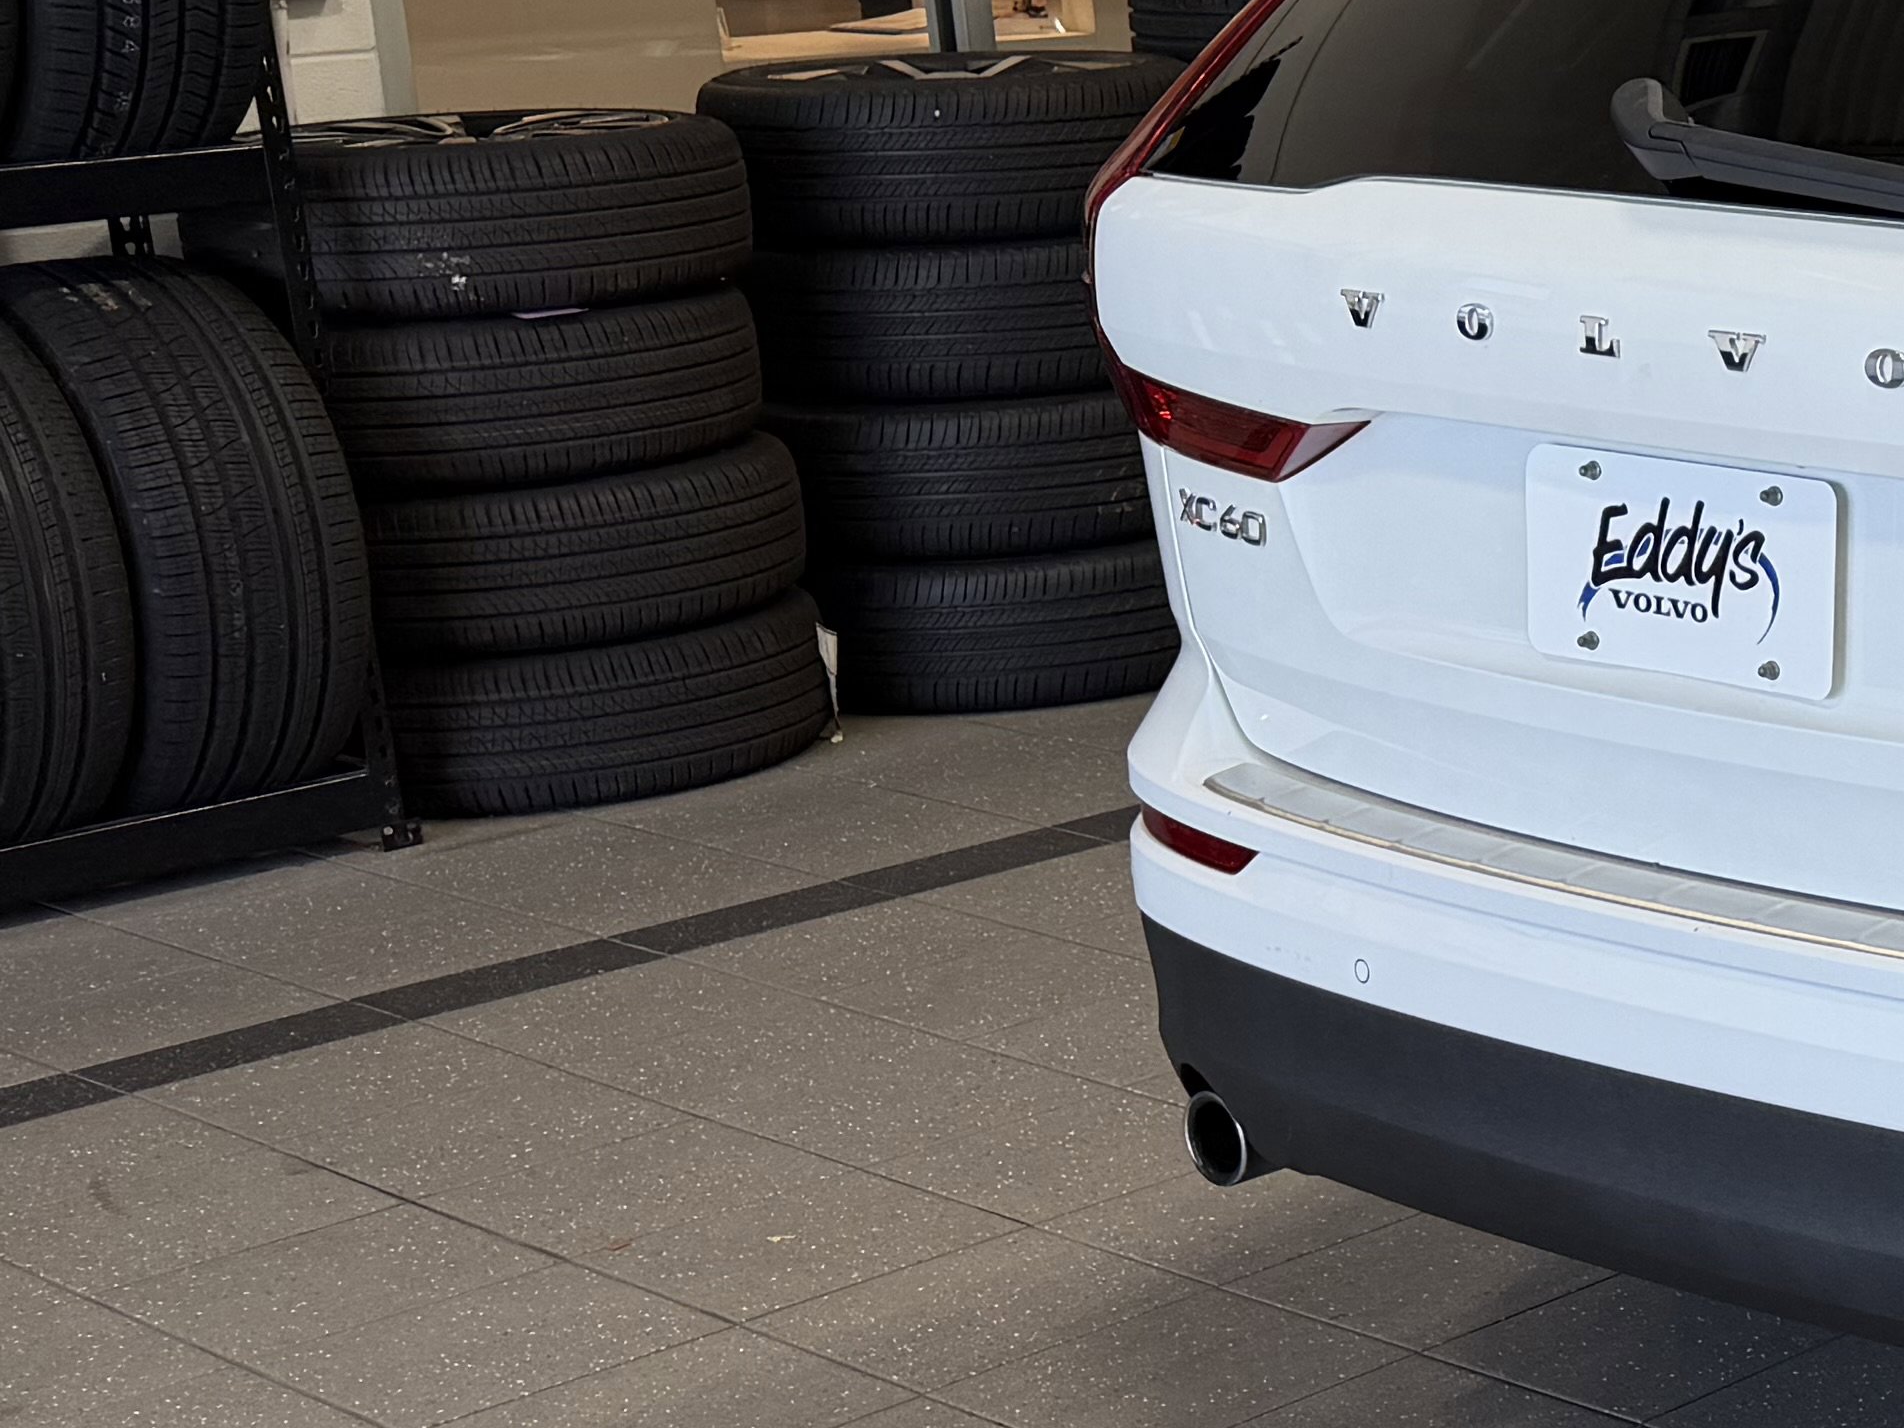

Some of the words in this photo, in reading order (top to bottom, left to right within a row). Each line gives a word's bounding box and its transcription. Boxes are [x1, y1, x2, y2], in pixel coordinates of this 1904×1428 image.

[1179, 487, 1267, 547] XC60
[1591, 496, 1766, 619] Eddy's
[1608, 587, 1709, 623] VOLVO
